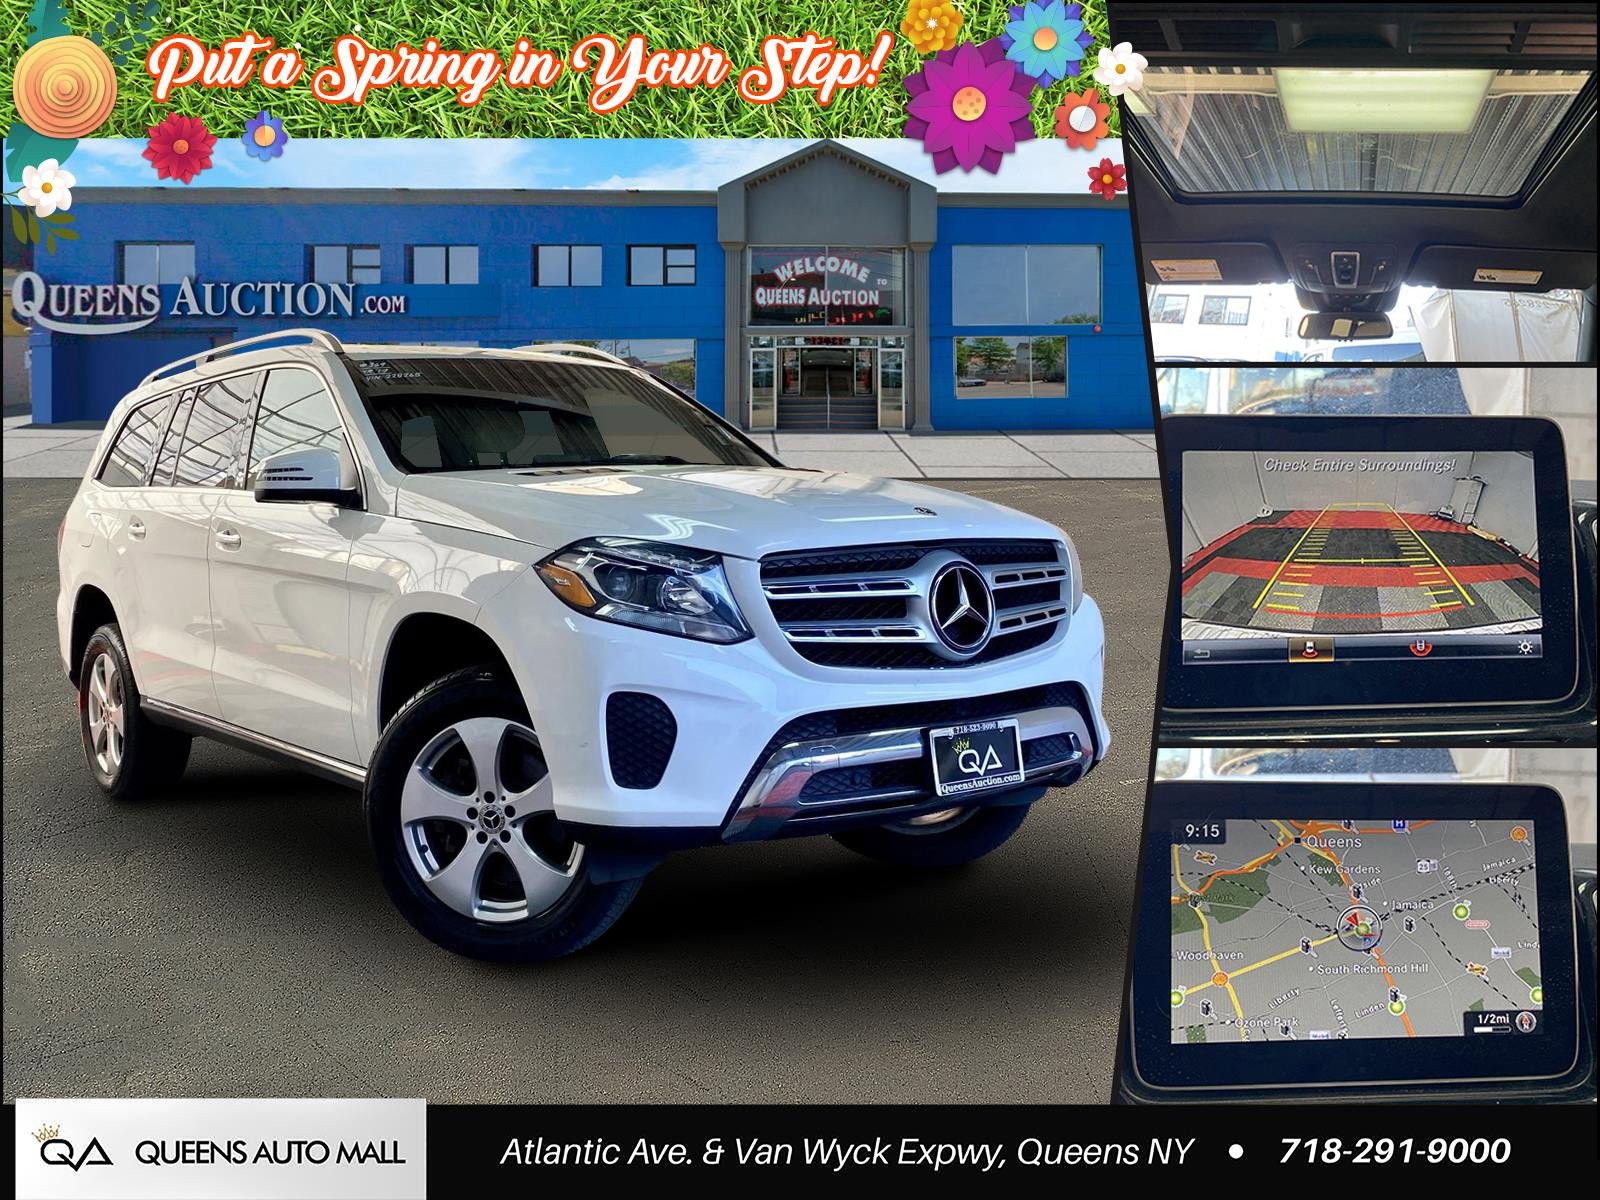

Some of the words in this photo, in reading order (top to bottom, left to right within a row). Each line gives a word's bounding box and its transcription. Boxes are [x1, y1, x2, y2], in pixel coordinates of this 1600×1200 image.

[773, 255, 872, 284] WELCOME
[876, 277, 889, 286] TO
[12, 271, 161, 335] QUEENS
[755, 286, 806, 307] QUEENS
[808, 287, 880, 306] AUCTION
[1263, 458, 1309, 472] Check
[1313, 458, 1355, 472] Entire
[1358, 458, 1457, 475] Surroundings!
[941, 773, 1021, 794] QueensAuction.com
[1185, 823, 1220, 838] 9:15
[1307, 835, 1362, 849] Queens
[1309, 863, 1333, 875] Kew
[1336, 864, 1381, 875] Gardens
[1482, 857, 1518, 872] Jamaica
[1391, 900, 1435, 911] Jamaica
[1317, 964, 1350, 975] South
[1353, 963, 1408, 974] Richmond
[1411, 962, 1429, 973] Hill
[1268, 988, 1300, 1009] Liberty
[1354, 1002, 1385, 1019] Linden
[1234, 1018, 1270, 1028] Ozone
[1273, 1016, 1299, 1028] Park
[1478, 1013, 1510, 1025] 1/2mi
